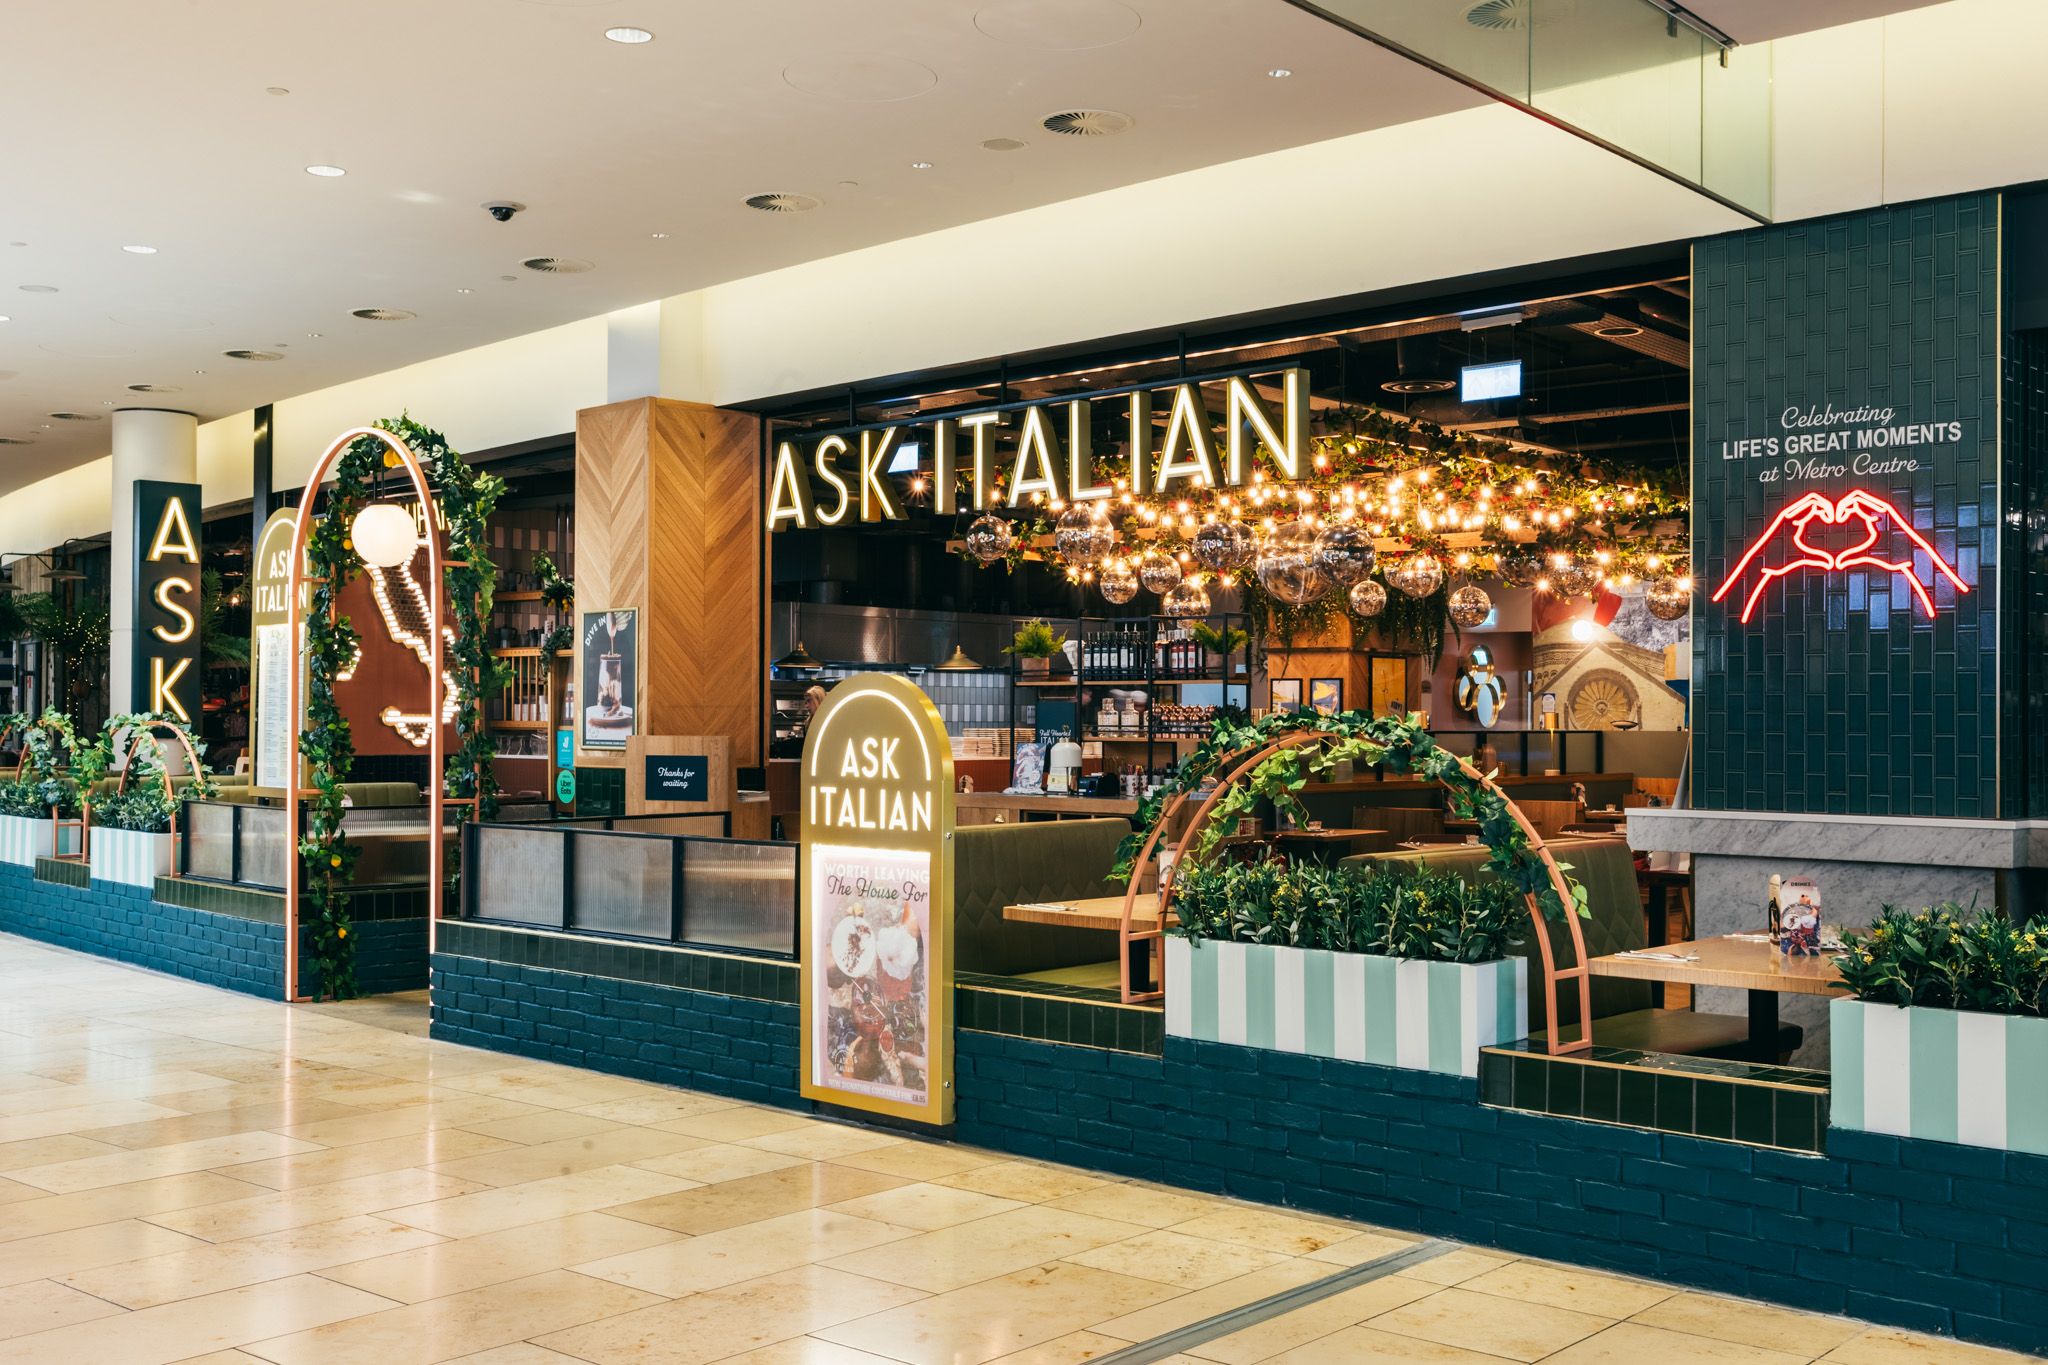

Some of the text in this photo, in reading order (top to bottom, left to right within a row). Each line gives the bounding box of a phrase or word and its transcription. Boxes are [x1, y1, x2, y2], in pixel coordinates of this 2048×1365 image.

[1782, 403, 1896, 429] Celebrating
[767, 368, 1307, 532] ASK ITALIAN
[1722, 421, 1962, 460] LIFE'S GREAT MOMENTS
[1759, 453, 1919, 482] at Metro Centre
[146, 496, 199, 724] ASK
[256, 582, 308, 613] ITALIN
[585, 615, 607, 646] DIVE IN
[657, 766, 695, 779] Thanks for
[840, 736, 900, 780] ASK
[560, 787, 571, 795] Eats
[663, 780, 688, 789] waiting
[811, 786, 931, 832] ITALIAN
[825, 863, 929, 884] WORTH LEAVING
[827, 874, 928, 902] The House For
